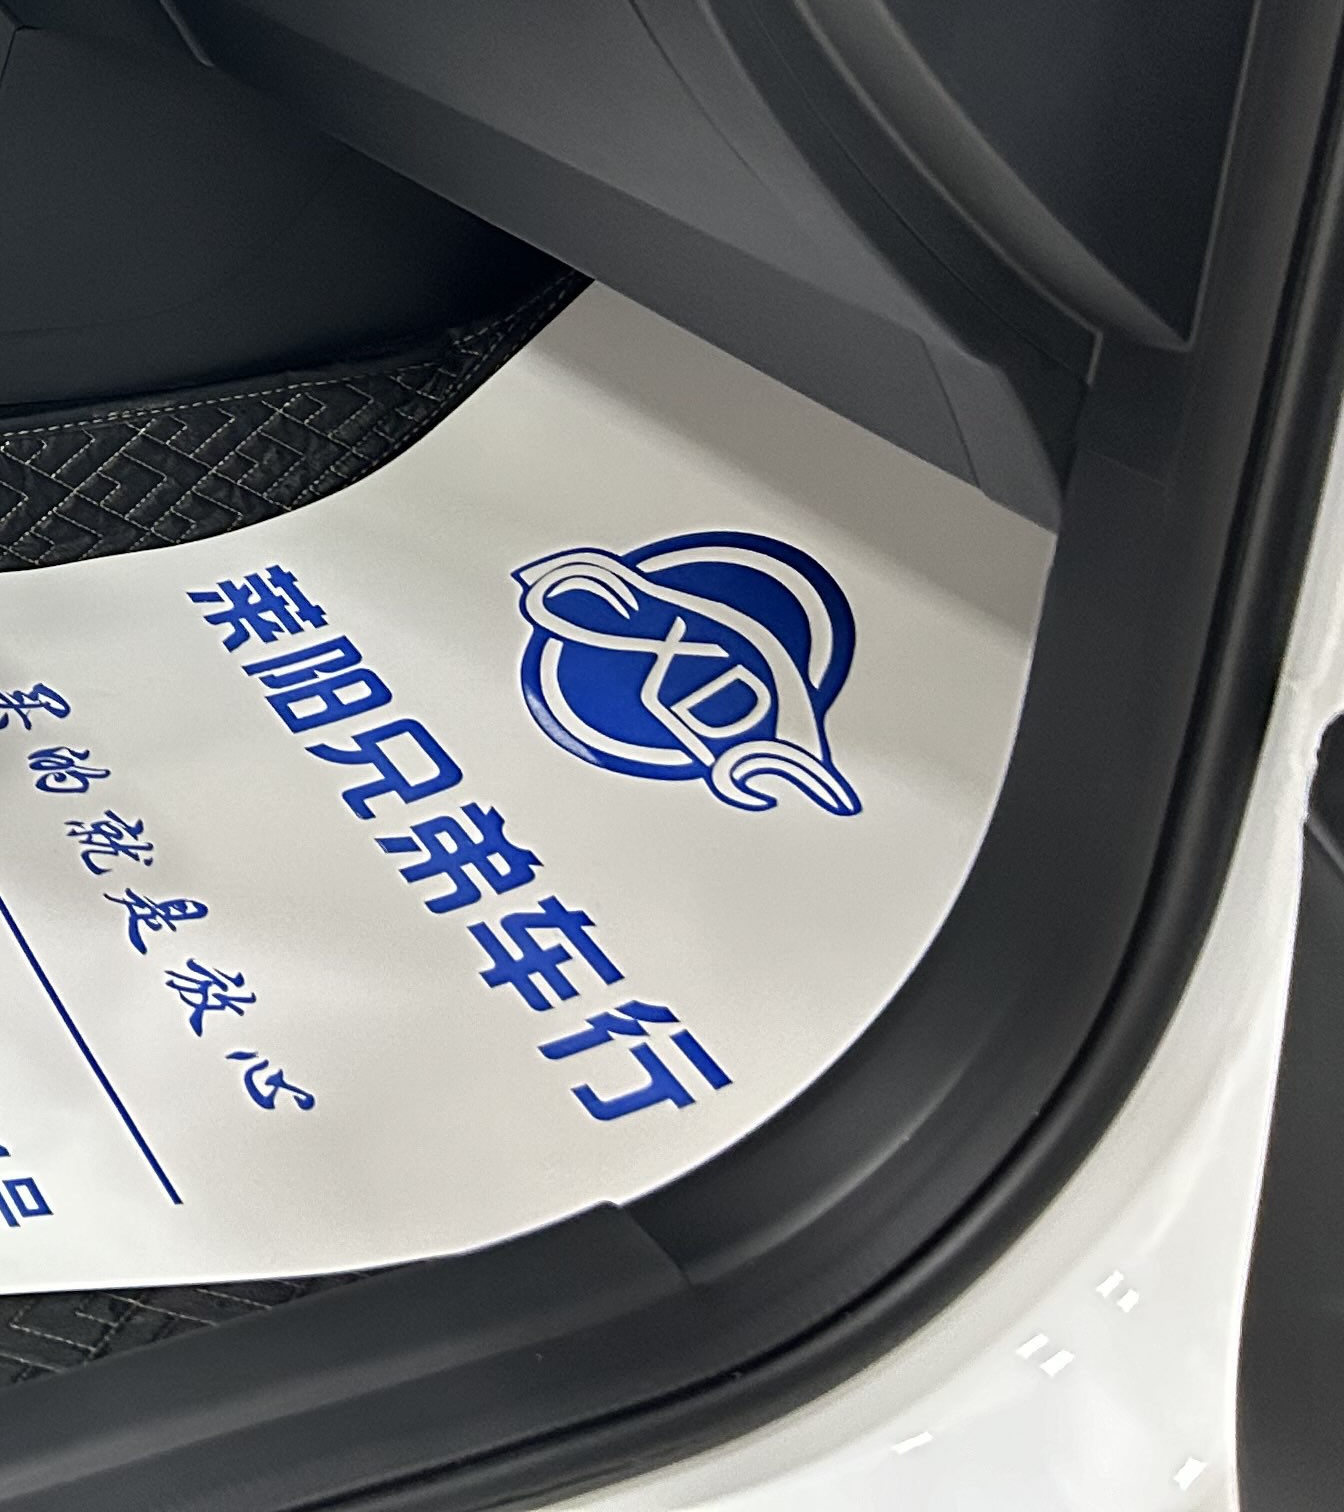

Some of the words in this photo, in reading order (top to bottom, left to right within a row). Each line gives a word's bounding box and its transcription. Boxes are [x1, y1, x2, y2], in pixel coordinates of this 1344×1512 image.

[186, 563, 732, 1122] 莱阳兄弟车行
